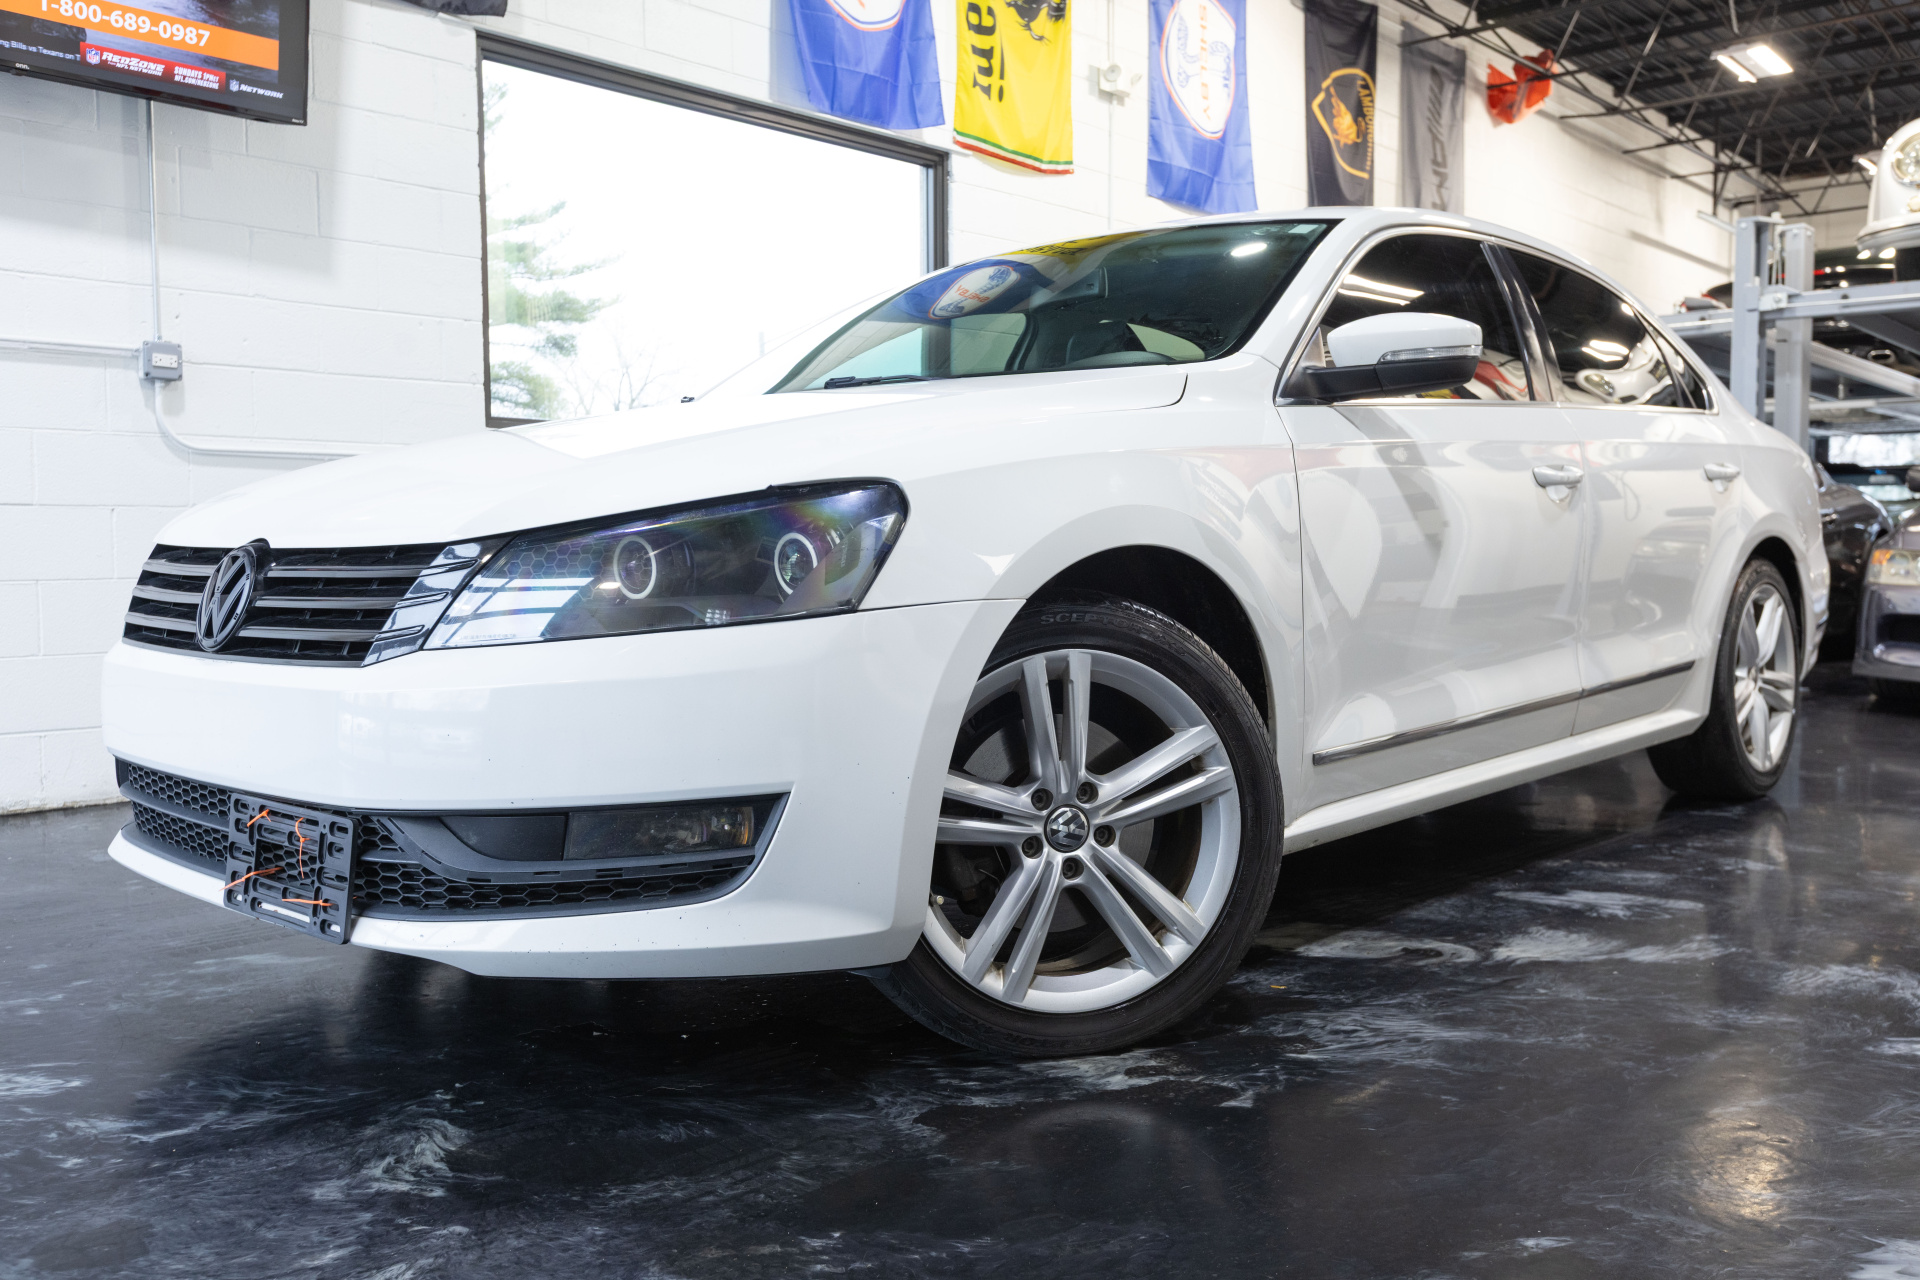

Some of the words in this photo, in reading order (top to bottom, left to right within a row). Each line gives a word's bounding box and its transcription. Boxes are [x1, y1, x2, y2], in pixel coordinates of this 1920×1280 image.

[10, 40, 27, 51] Bills
[37, 46, 64, 58] Texans
[174, 65, 202, 79] SUNDAYS
